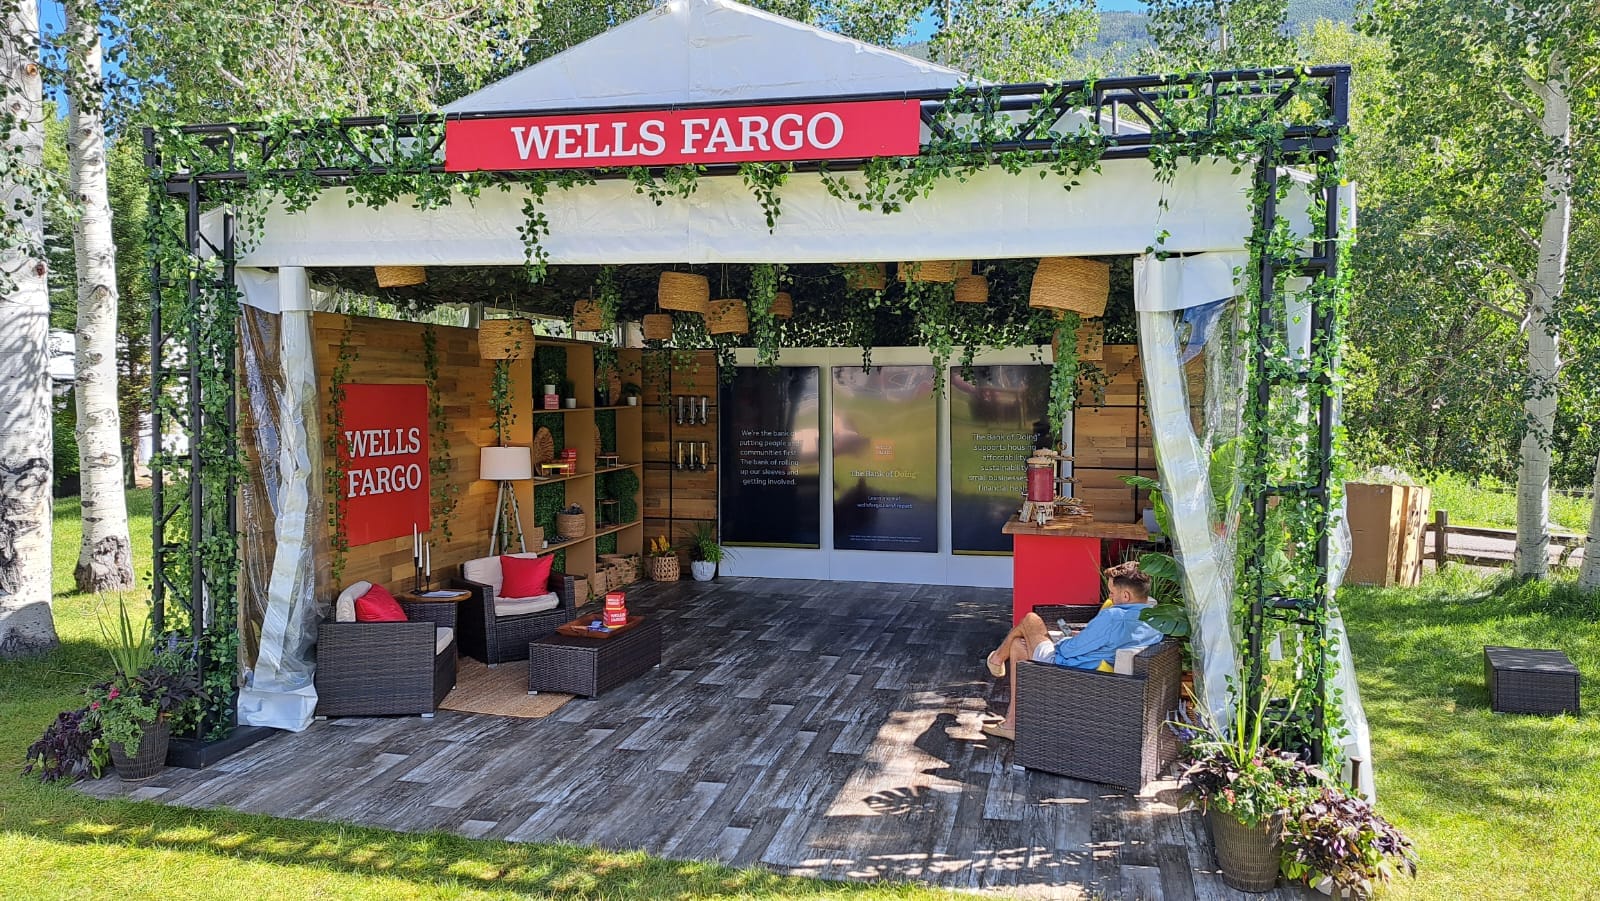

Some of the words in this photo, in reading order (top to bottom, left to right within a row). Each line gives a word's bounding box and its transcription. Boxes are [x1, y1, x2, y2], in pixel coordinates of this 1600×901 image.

[511, 119, 665, 159] WELLS
[680, 112, 844, 154] FARGO
[761, 429, 772, 437] the
[972, 433, 986, 441] The
[344, 427, 421, 458] WELLS
[739, 440, 763, 448] putting
[764, 440, 787, 448] people
[973, 444, 1006, 452] supports
[1007, 444, 1037, 453] housing
[778, 459, 799, 467] rolling
[762, 468, 786, 476] sleeves
[787, 468, 799, 476] and
[347, 463, 422, 498] FARGO
[743, 478, 767, 486] getting
